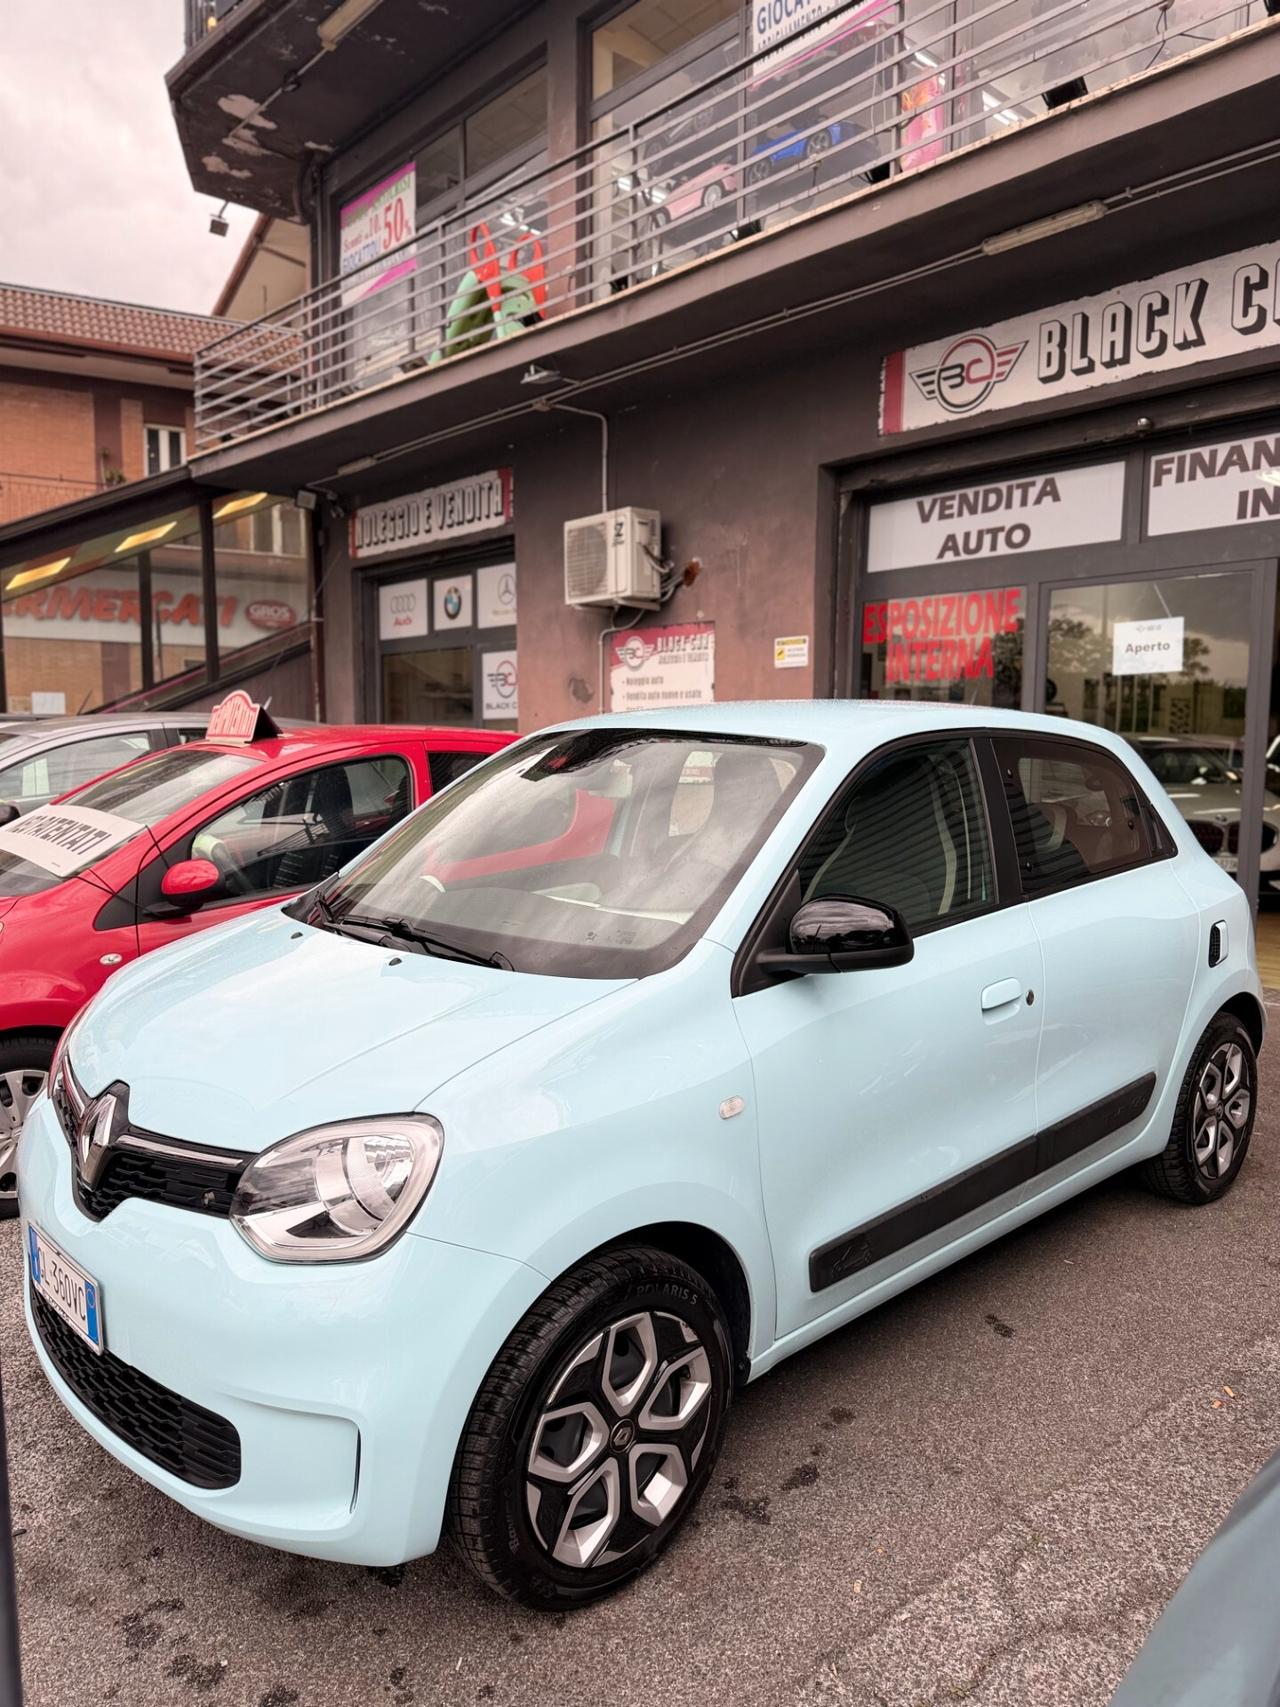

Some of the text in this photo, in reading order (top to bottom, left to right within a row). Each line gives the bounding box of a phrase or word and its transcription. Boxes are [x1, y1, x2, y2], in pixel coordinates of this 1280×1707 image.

[1037, 277, 1209, 384] BLACK
[1231, 256, 1280, 335] C
[1153, 437, 1280, 488] FINAN
[424, 499, 432, 533] E
[437, 479, 504, 530] VENDITA
[916, 477, 1061, 523] VENDITA
[1237, 486, 1280, 520] IN
[936, 523, 1031, 560] AUTO
[249, 604, 290, 619] GROS
[863, 588, 1022, 645] ESPOSIZIONE
[886, 637, 993, 682] INTERNA
[1125, 641, 1171, 656] Aperto
[637, 1283, 689, 1300] POLARIS
